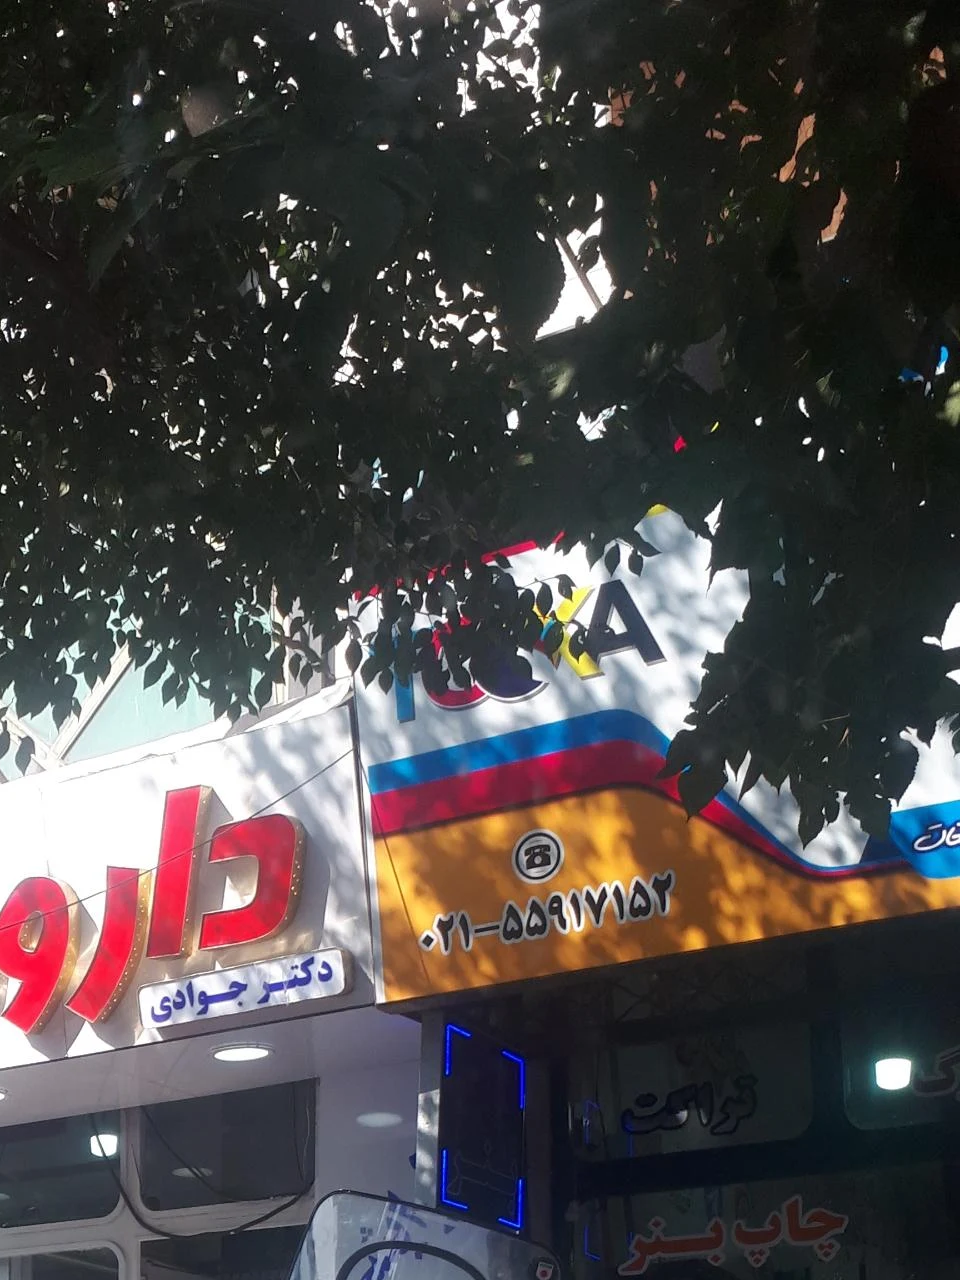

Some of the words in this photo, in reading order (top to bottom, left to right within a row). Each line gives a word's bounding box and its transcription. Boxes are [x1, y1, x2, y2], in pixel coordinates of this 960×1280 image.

[150, 979, 249, 1024] جوادی
[257, 956, 334, 1005] دکتر
[617, 1215, 726, 1276] بنر
[733, 1194, 850, 1268] چاپ
